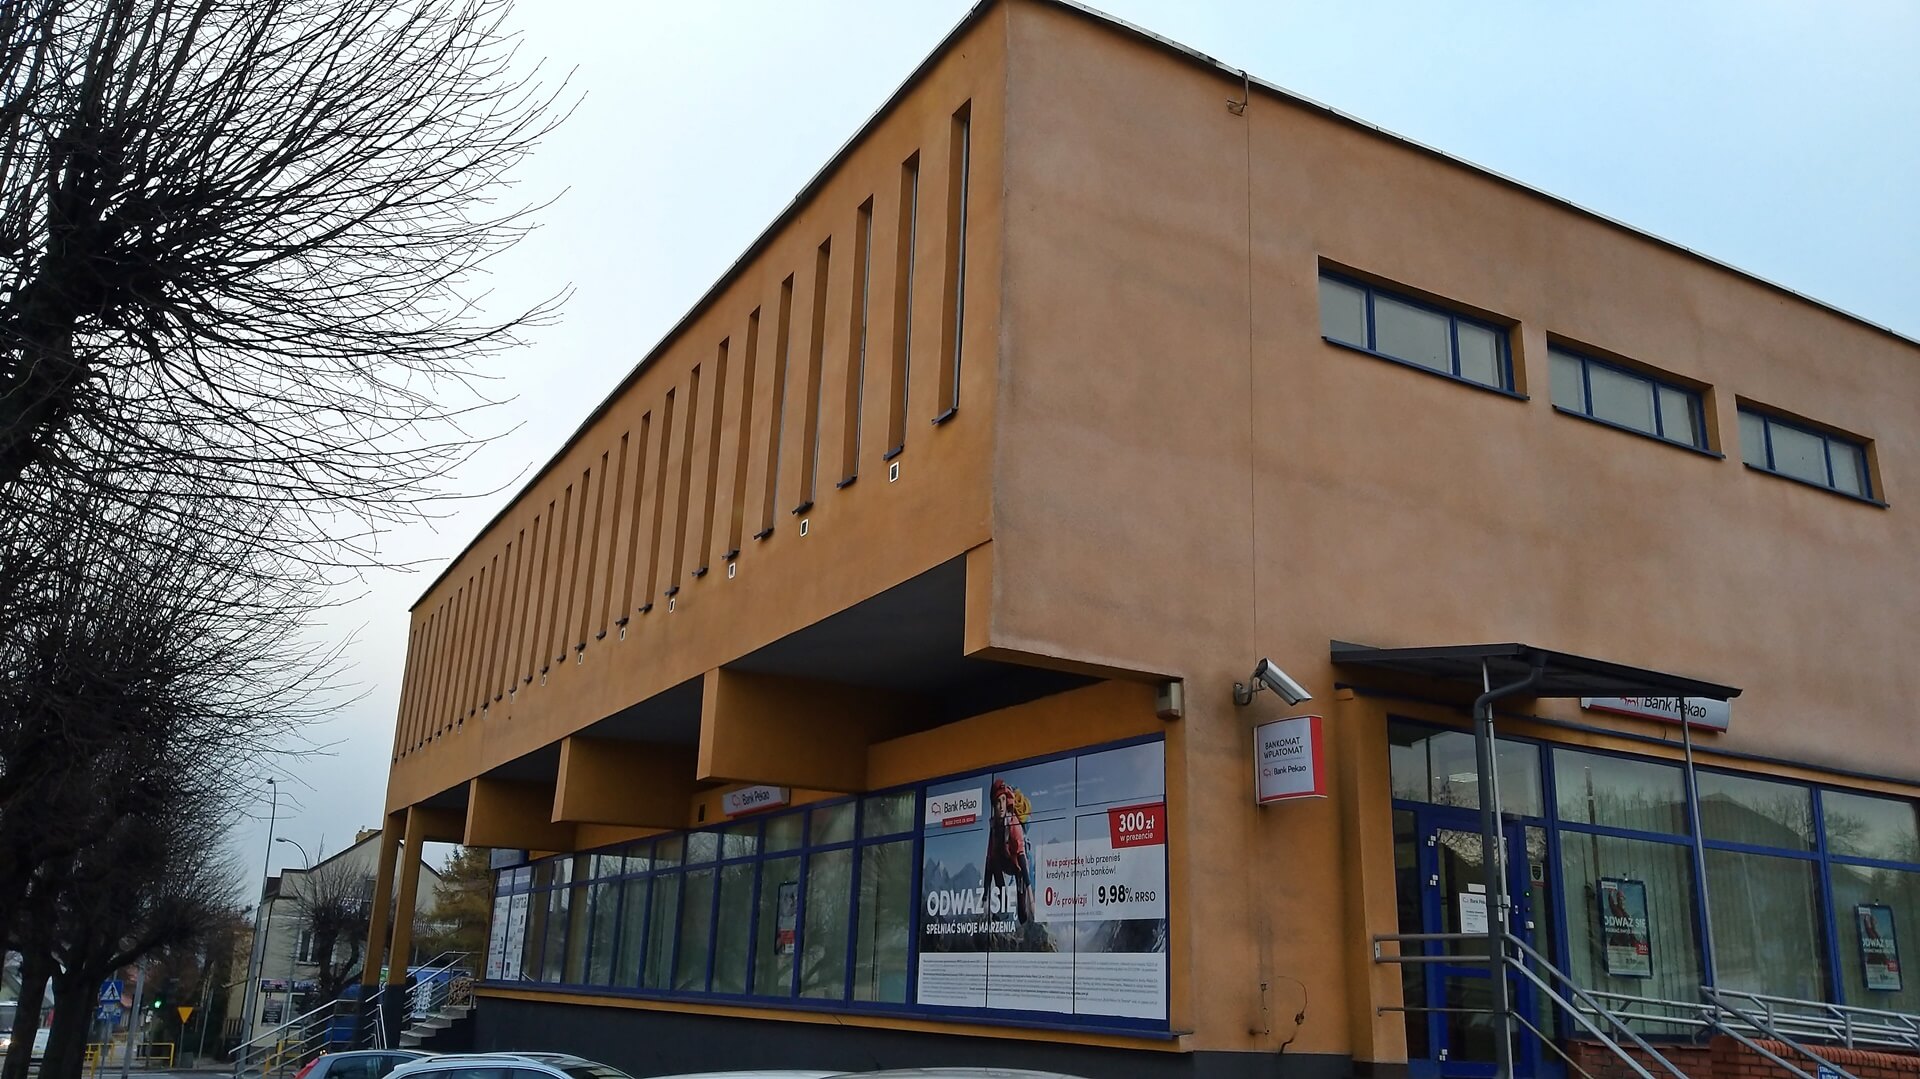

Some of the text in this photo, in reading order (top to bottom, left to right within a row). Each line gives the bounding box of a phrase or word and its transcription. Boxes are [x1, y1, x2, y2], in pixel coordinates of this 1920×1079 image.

[1644, 697, 1707, 718] Bank Pekao
[1265, 737, 1300, 750] BANKOMAT
[1274, 765, 1306, 775] Bank Pekao
[944, 799, 976, 813] Bank Pekao
[1119, 812, 1154, 832] 300 zł
[1126, 831, 1153, 842] prezencie
[1086, 855, 1095, 864] lub
[1096, 852, 1120, 865] przenieś
[1046, 869, 1066, 879] kredyty
[1091, 865, 1116, 875] banków!
[927, 880, 1018, 920] ODWAŻ SIĘ
[1062, 893, 1087, 907] prowizji
[1098, 884, 1133, 906] 9,98%
[1135, 891, 1156, 902] RRSO
[926, 920, 1016, 936] SPEŁNIAĆ SWOJE MARZENIA
